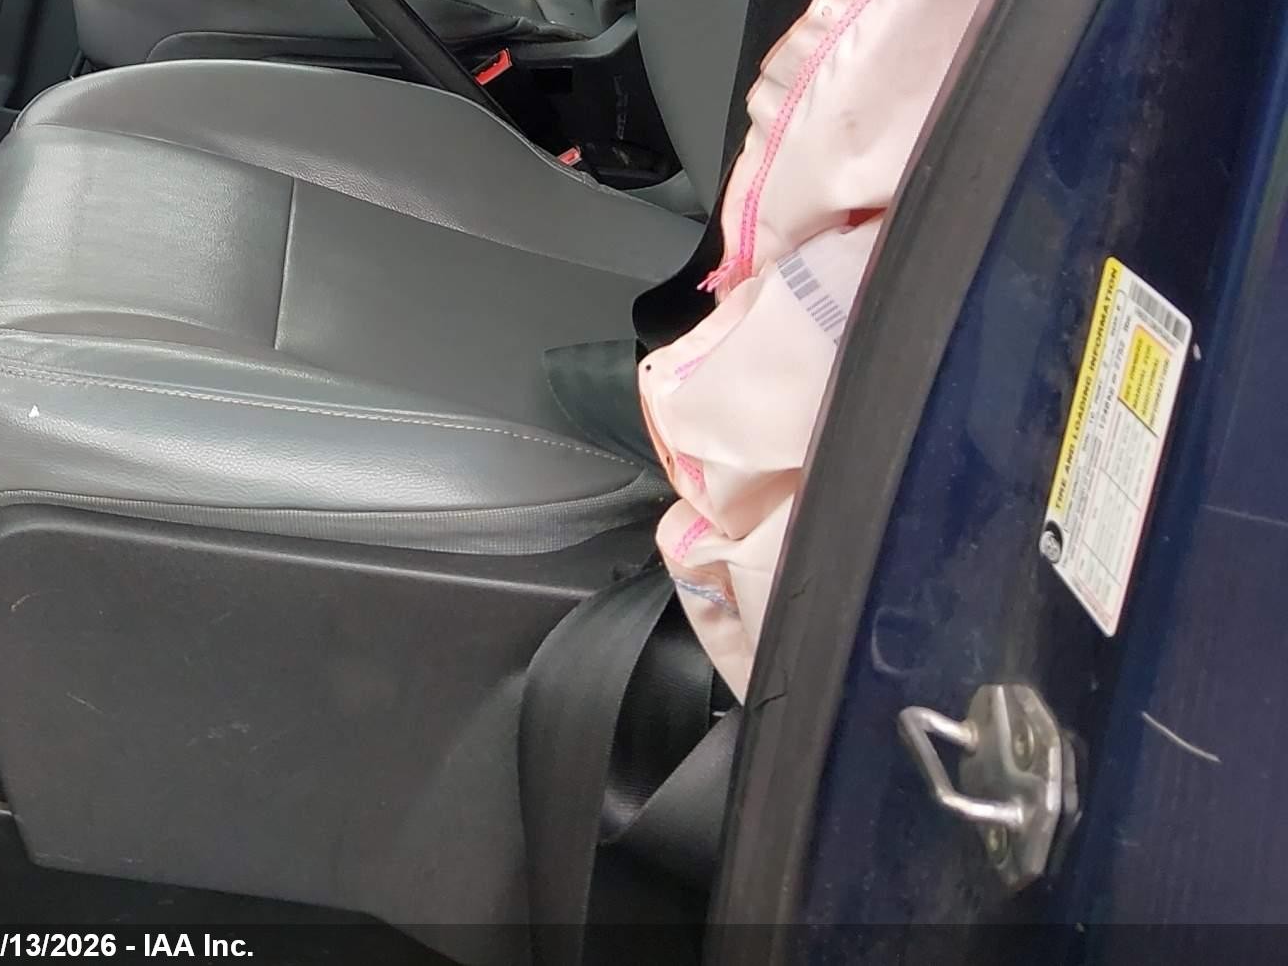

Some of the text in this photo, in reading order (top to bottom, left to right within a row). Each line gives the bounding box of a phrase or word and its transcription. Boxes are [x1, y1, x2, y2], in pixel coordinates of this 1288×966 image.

[1055, 477, 1067, 510] TIRE
[1064, 442, 1076, 474] AND
[1073, 375, 1093, 441] LOADING
[1089, 266, 1118, 372] INFORMATION
